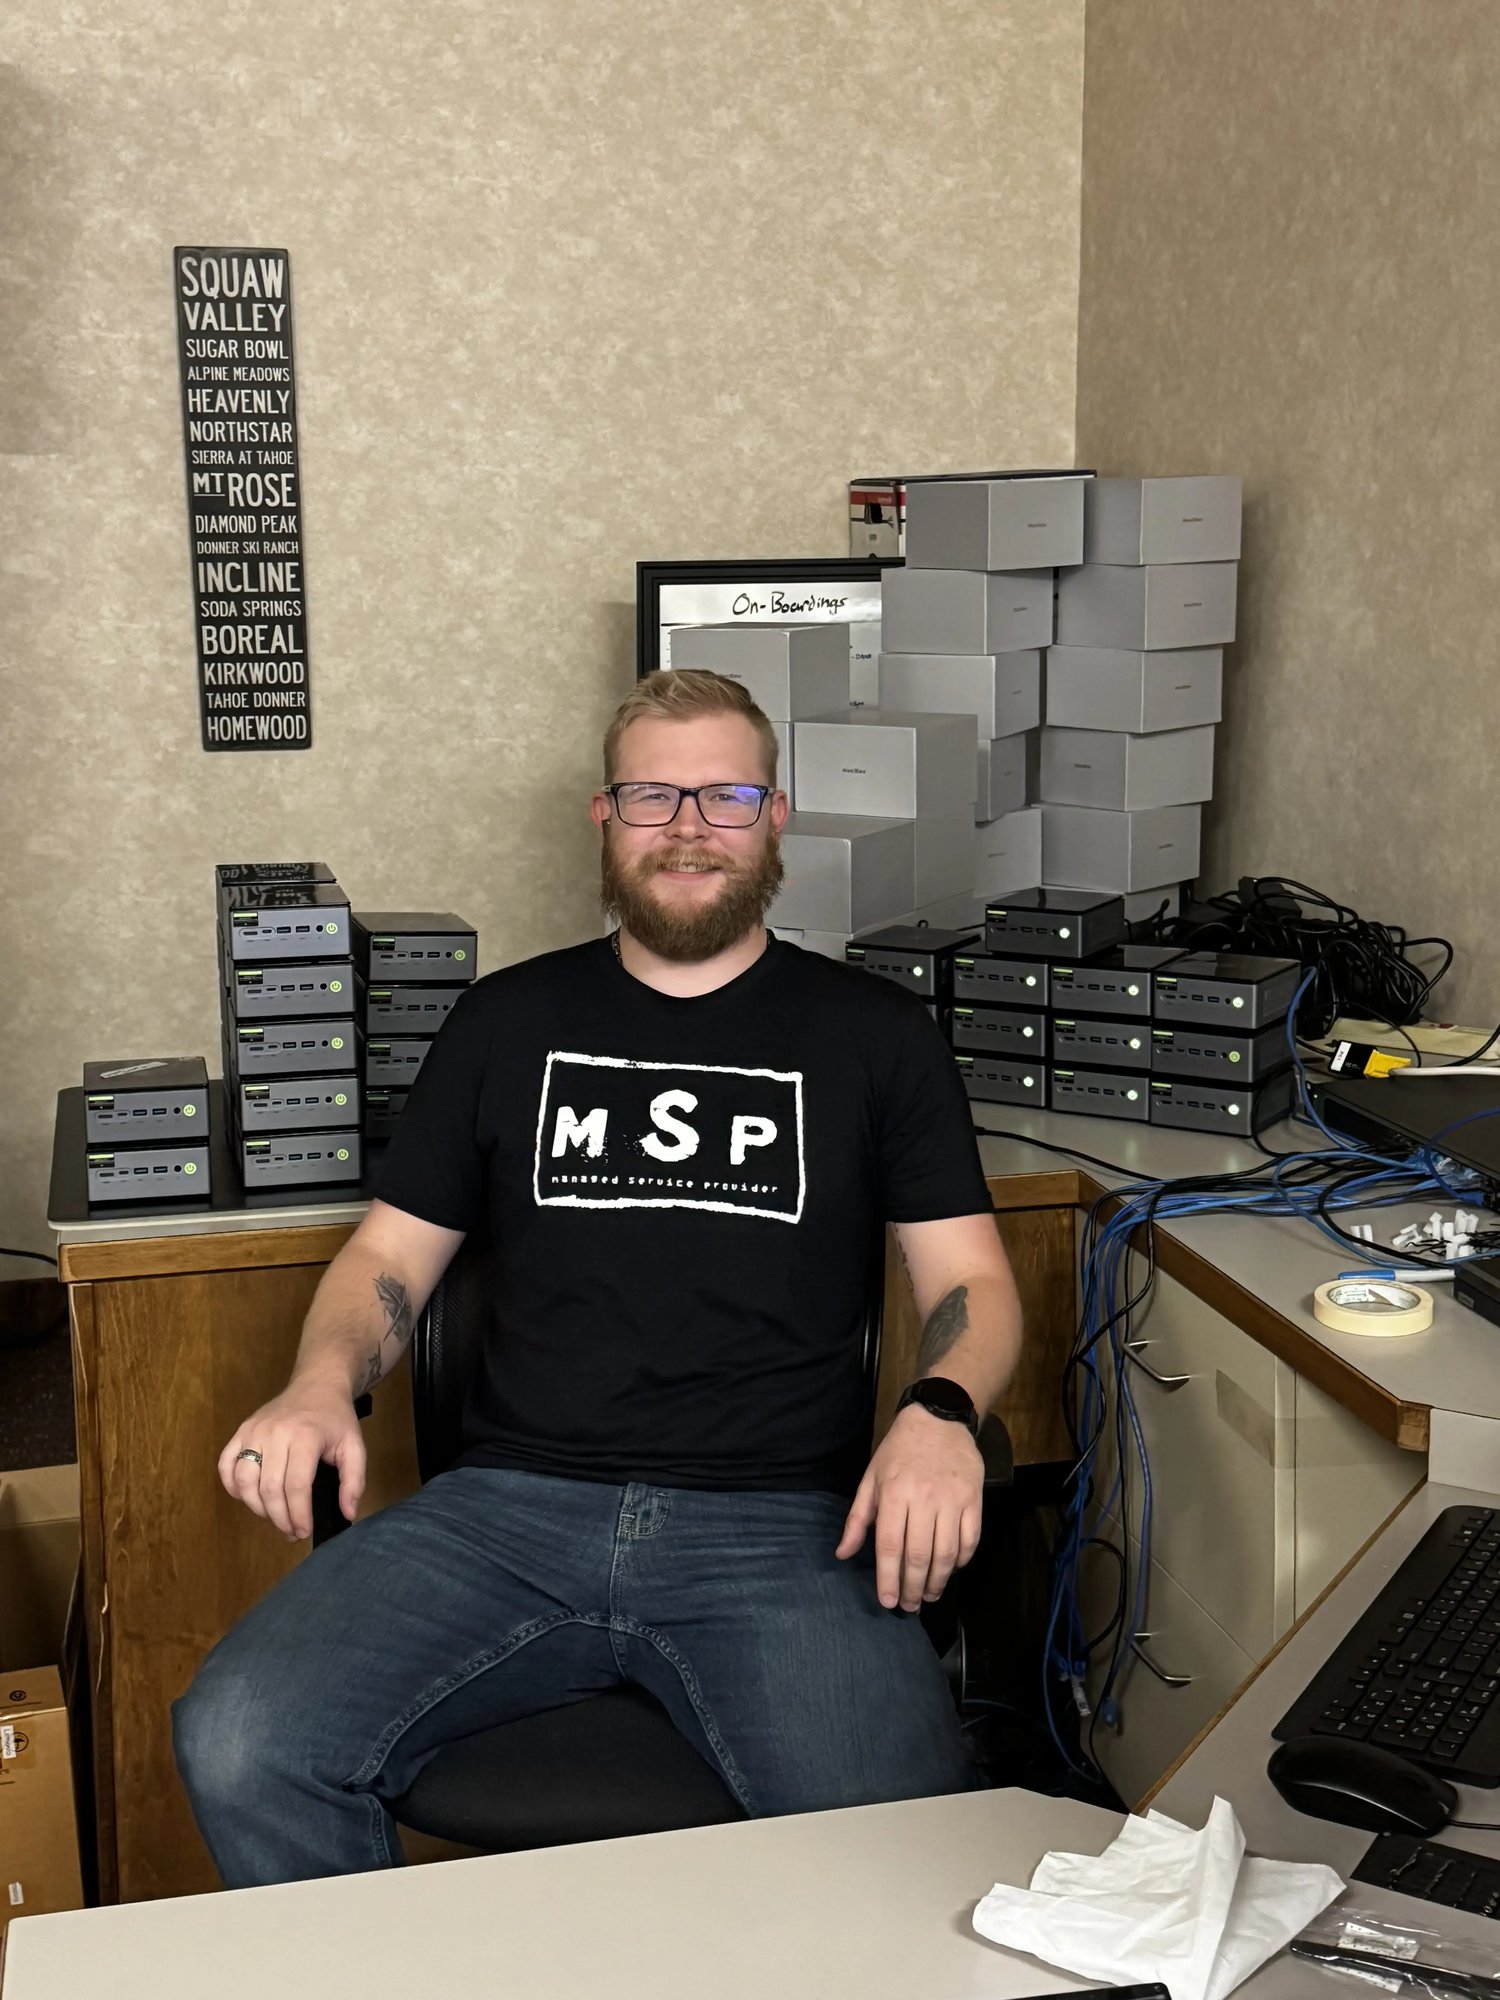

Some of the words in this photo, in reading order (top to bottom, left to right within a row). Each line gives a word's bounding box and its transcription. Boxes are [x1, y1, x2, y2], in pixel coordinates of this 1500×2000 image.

[181, 256, 284, 300] SQUAW
[182, 301, 286, 332] VALLEY
[185, 338, 239, 359] SUGAR
[244, 339, 289, 360] BOWL
[187, 366, 230, 381] ALPINE
[233, 366, 290, 382] MEADOWS
[187, 388, 290, 414] HEAVENLY
[189, 420, 293, 443] NORTHSTAR
[191, 449, 235, 465] SIERRA
[238, 450, 253, 465] AT
[256, 450, 295, 465] TAHOE
[193, 472, 226, 497] MT
[227, 472, 297, 507] ROSE
[195, 514, 257, 534] DIAMOND
[261, 514, 298, 534] PEAK
[196, 541, 240, 555] DONNER
[242, 541, 260, 554] SKI
[263, 541, 299, 554] RANCH
[198, 561, 301, 593] INCLINE
[200, 600, 238, 618] SODA
[242, 600, 302, 617] SPRINGS
[201, 624, 304, 655] BOREAL
[204, 661, 305, 686] KIRKWOOD
[205, 692, 250, 709] TAHOE
[253, 691, 306, 708] DONNER
[207, 714, 307, 741] HOMEWOOD
[551, 1175, 619, 1185] managed
[628, 1176, 694, 1188] service
[703, 1181, 778, 1194] provider
